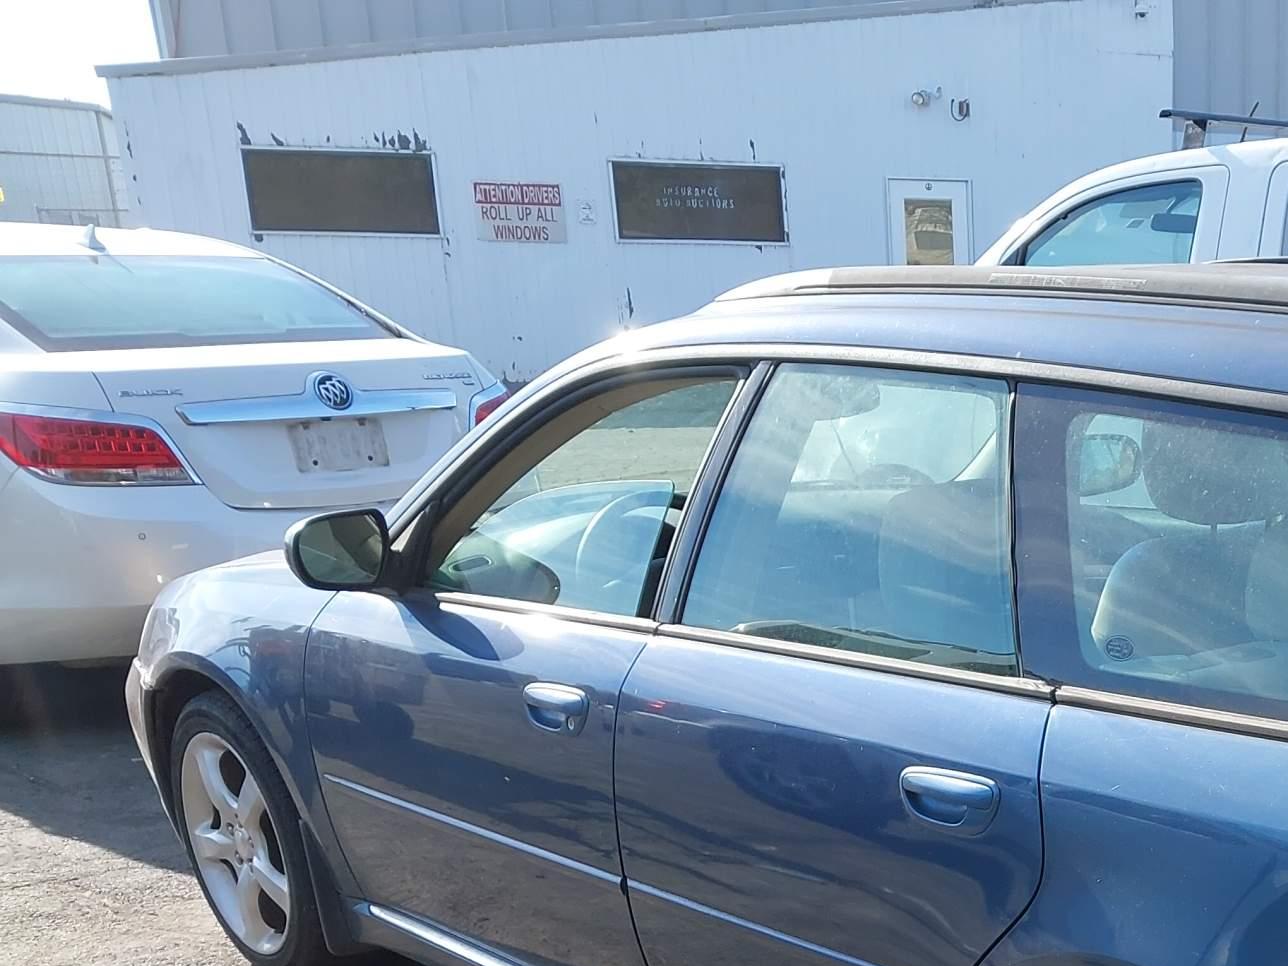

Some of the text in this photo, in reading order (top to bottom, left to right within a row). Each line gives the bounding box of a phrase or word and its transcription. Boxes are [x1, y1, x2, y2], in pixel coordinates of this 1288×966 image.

[476, 184, 560, 204] ATTENTION DRIVERS
[663, 186, 719, 196] INSURANCE
[481, 205, 559, 223] ROLL UP ALL
[492, 224, 550, 241] WINDOWS
